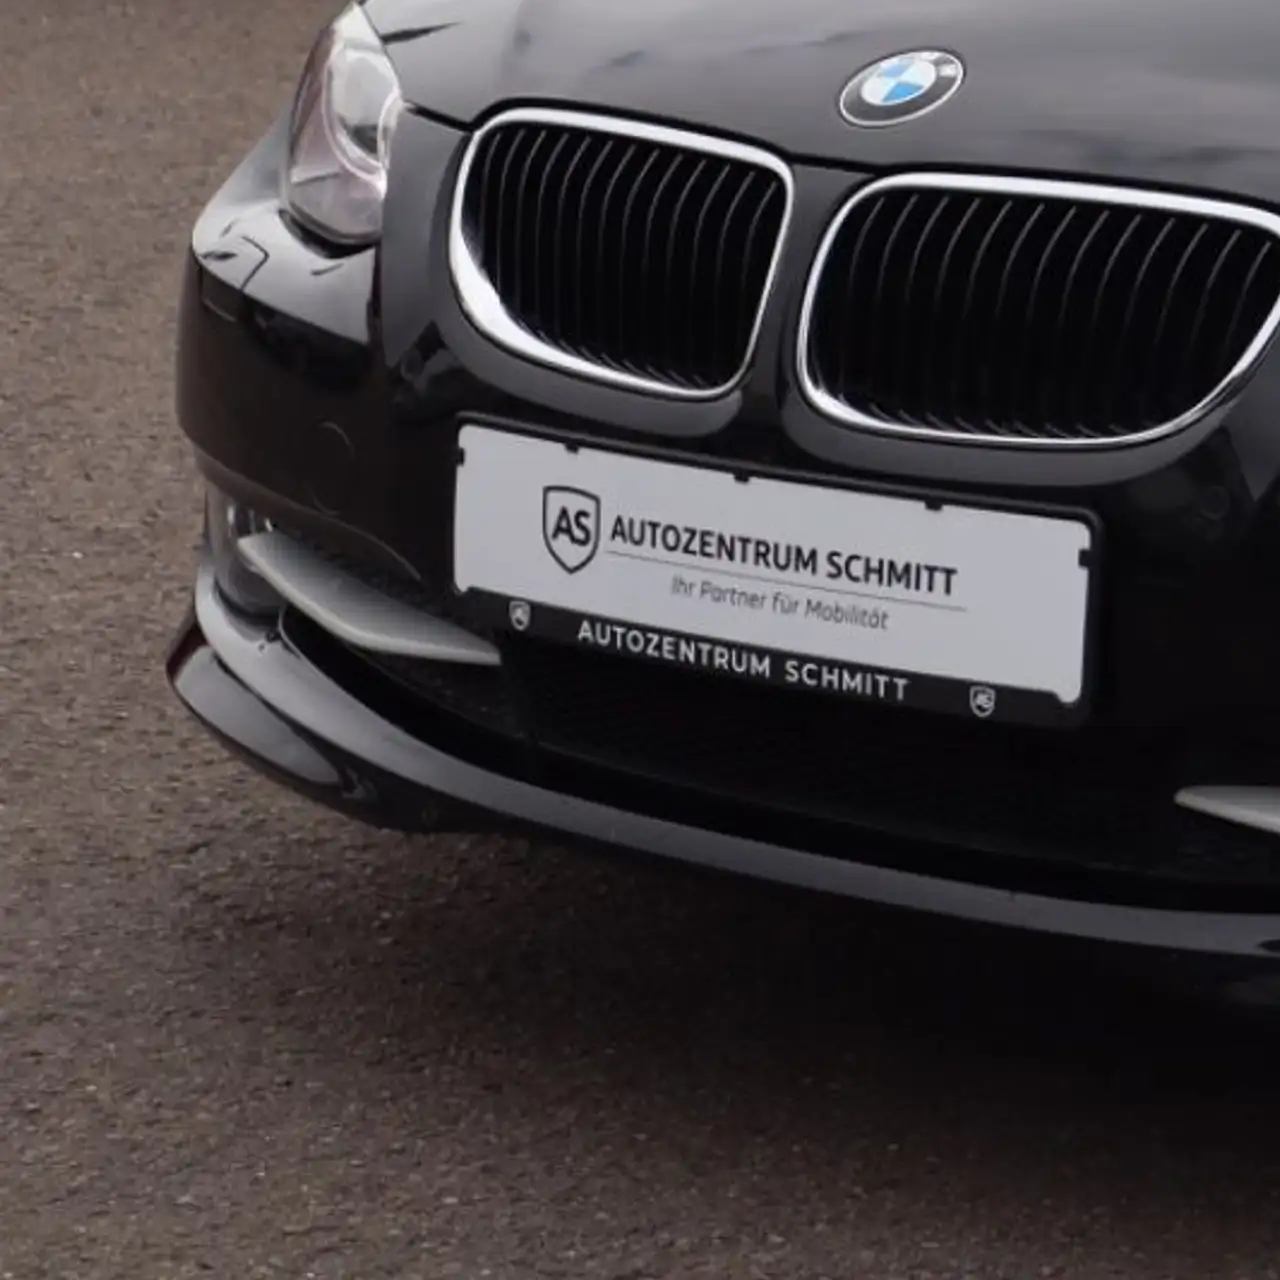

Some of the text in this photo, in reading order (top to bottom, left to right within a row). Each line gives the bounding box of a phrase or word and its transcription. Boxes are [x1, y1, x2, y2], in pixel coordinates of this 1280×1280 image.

[552, 507, 591, 546] AS
[611, 515, 958, 595] AUTOZENTRUM SCHMITT
[671, 576, 696, 598] Ihr
[700, 580, 766, 610] Partner
[772, 591, 800, 614] für
[577, 620, 911, 701] AUTOZENTRUM SCHMITT
